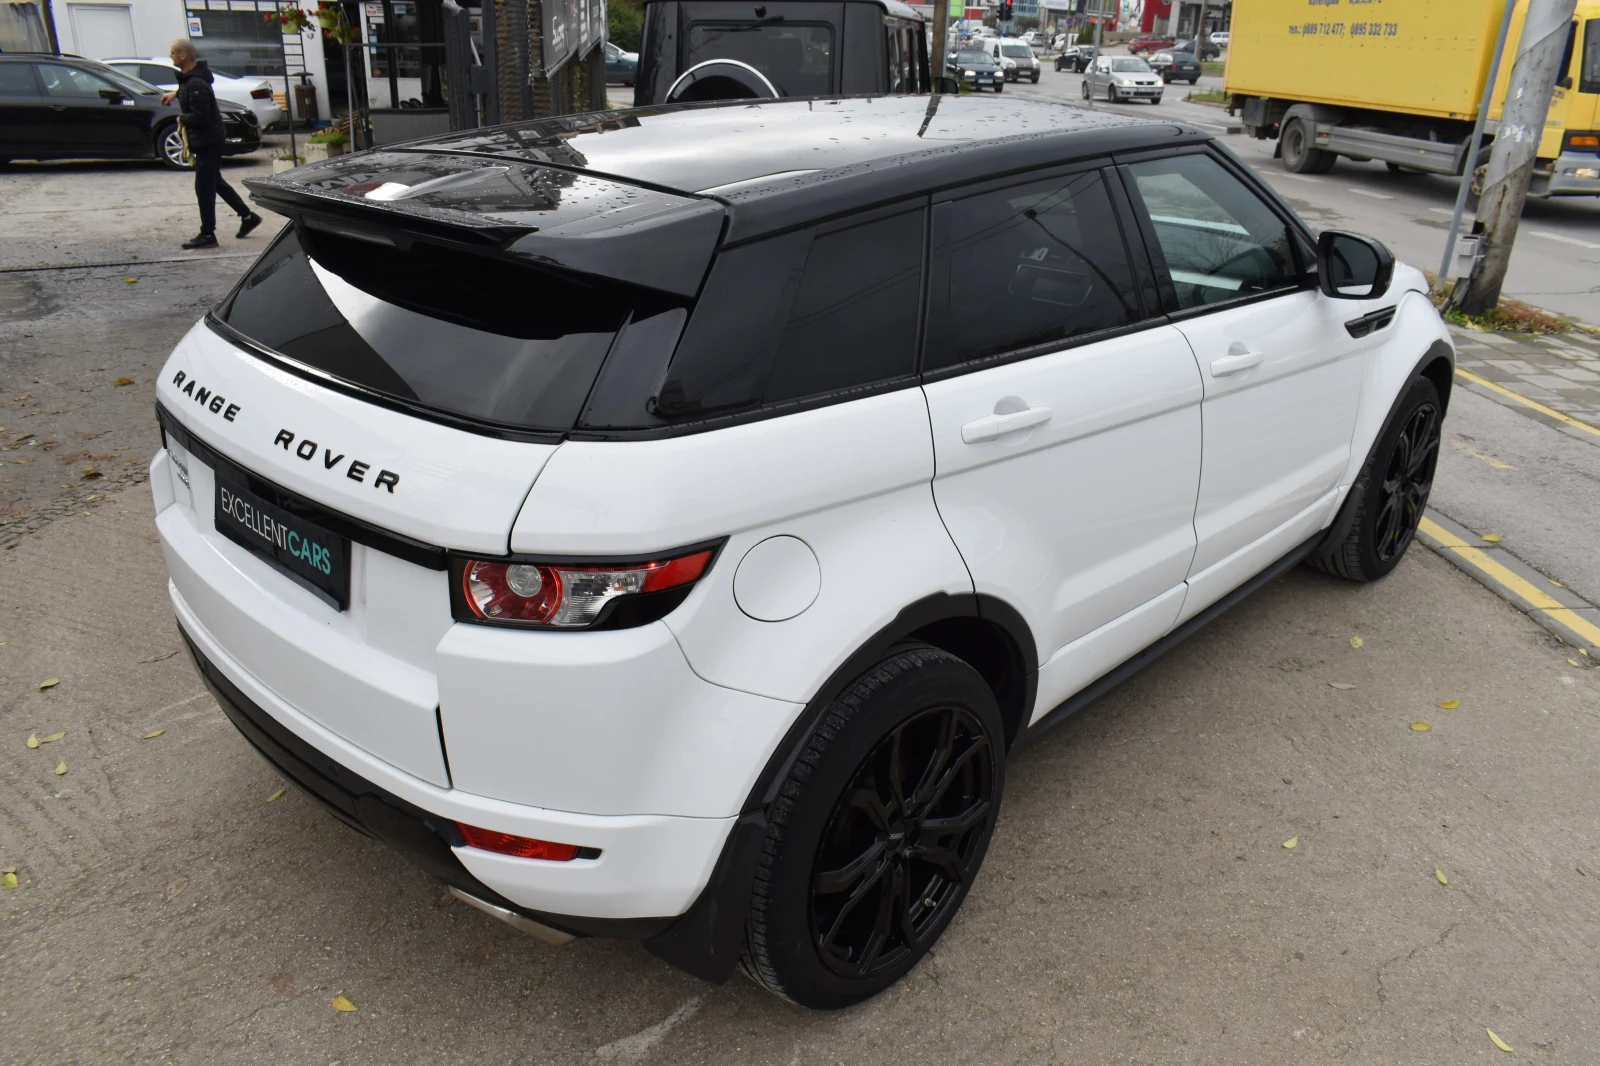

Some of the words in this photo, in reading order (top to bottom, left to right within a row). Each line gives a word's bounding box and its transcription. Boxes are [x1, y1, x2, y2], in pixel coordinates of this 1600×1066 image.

[1319, 22, 1331, 35] 712
[1350, 23, 1367, 36] 0895
[1368, 23, 1382, 36] 332
[1384, 23, 1398, 36] 733
[172, 370, 241, 422] RANGE
[274, 428, 400, 494] ROVER
